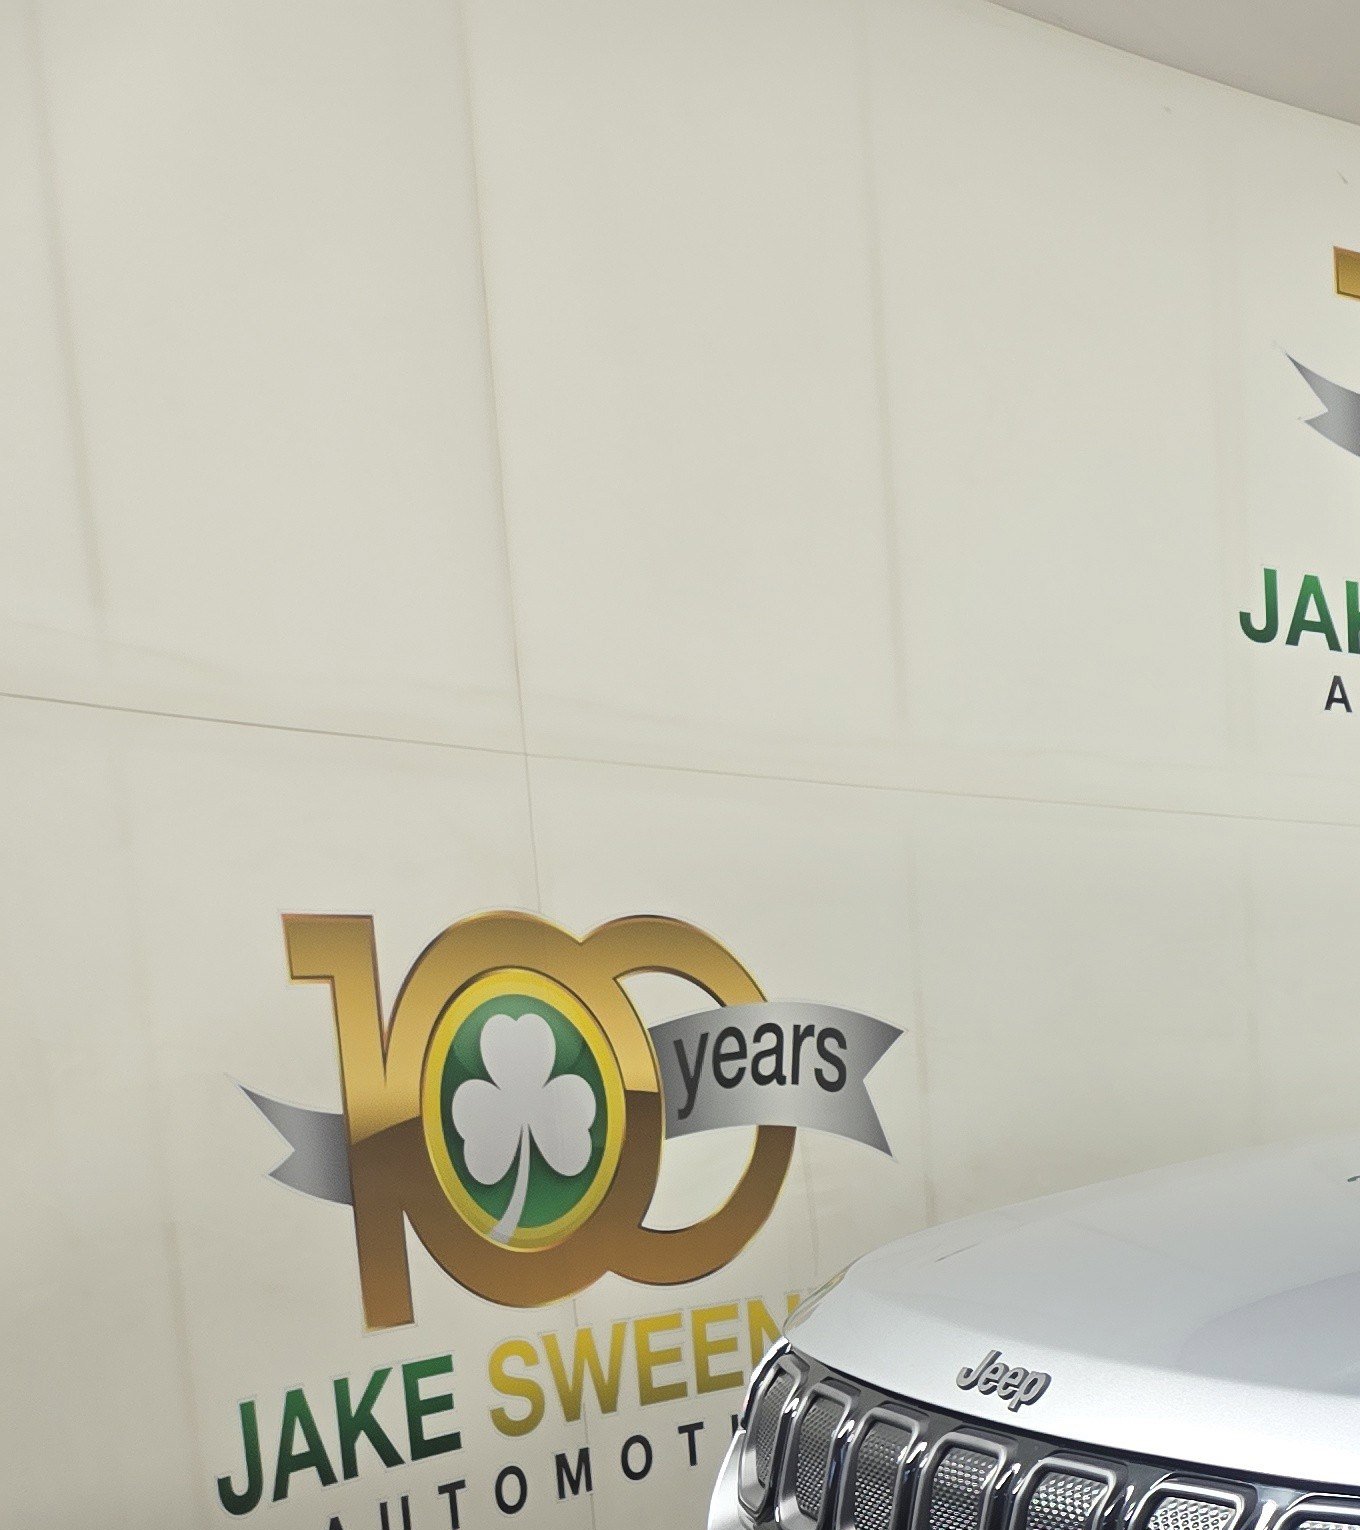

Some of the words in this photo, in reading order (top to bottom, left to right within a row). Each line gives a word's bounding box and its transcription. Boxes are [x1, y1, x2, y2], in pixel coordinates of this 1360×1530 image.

[282, 910, 796, 1330] 100
[672, 1021, 848, 1118] years
[217, 1355, 462, 1516] JAKE
[488, 1294, 800, 1437] SWEEN
[956, 1349, 1052, 1413] Jeep
